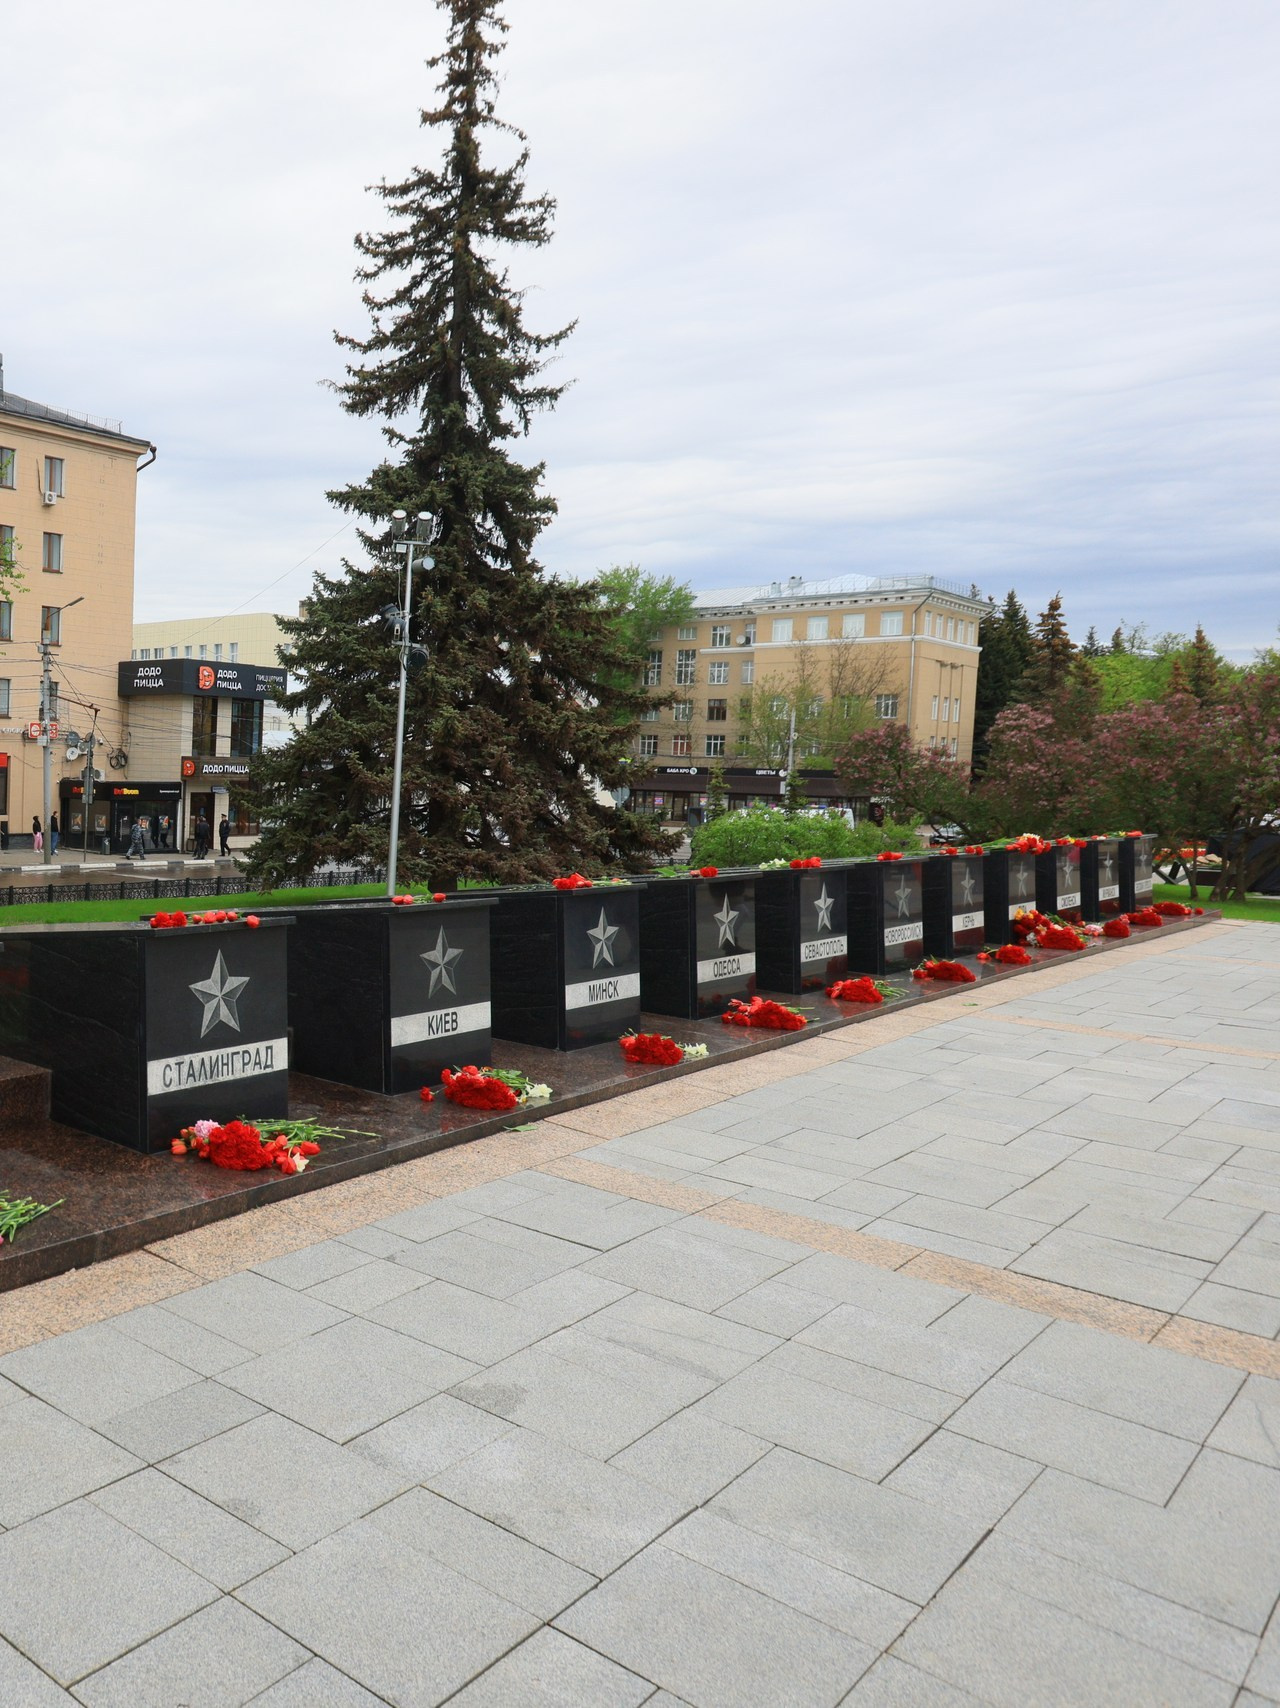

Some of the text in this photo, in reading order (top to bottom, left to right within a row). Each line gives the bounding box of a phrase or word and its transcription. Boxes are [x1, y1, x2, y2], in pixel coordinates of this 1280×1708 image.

[137, 666, 162, 677] ДОДО
[217, 669, 238, 679] ДОДО
[133, 678, 164, 688] ПИЦЦА
[216, 680, 243, 691] ПИЦЦА
[202, 764, 250, 774] ДОДО ПИЦЦА
[885, 923, 922, 945] НОВОРОССИЙСК
[804, 939, 845, 960] СЕВАСТОПОЛЬ
[713, 957, 742, 978] ОДЕССА
[587, 978, 620, 1003] МИНСК
[426, 1010, 459, 1037] КИЕВ
[161, 1044, 275, 1089] СТАЛИНГРАД
